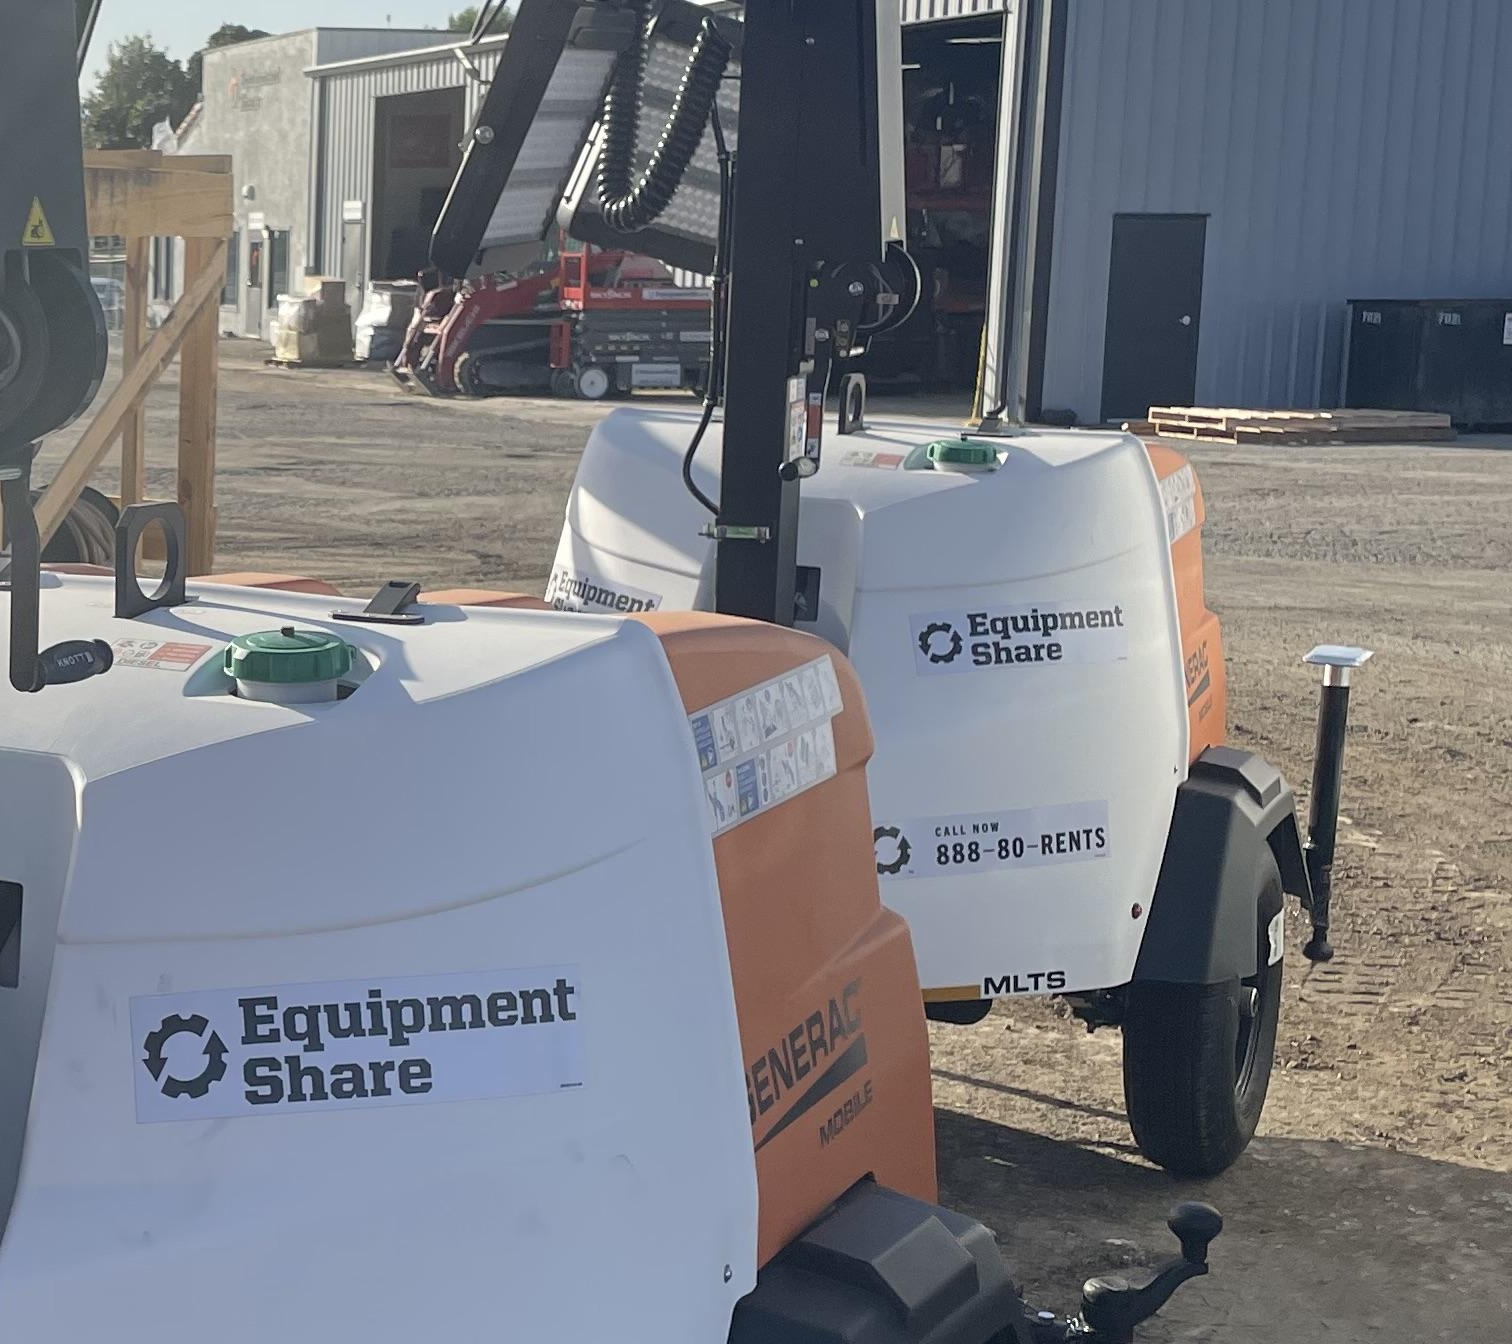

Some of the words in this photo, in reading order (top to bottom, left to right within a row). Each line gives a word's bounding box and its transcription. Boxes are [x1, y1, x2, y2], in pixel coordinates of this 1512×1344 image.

[967, 605, 1124, 640] Equipment
[971, 641, 1063, 666] Share
[934, 825, 966, 838] CALL
[972, 822, 999, 834] NOW
[936, 827, 1106, 865] 888-80-RENTS
[984, 971, 1066, 995] MLTS
[238, 978, 577, 1052] Equipment
[243, 1055, 432, 1105] Share
[819, 1079, 873, 1147] MOBILE
